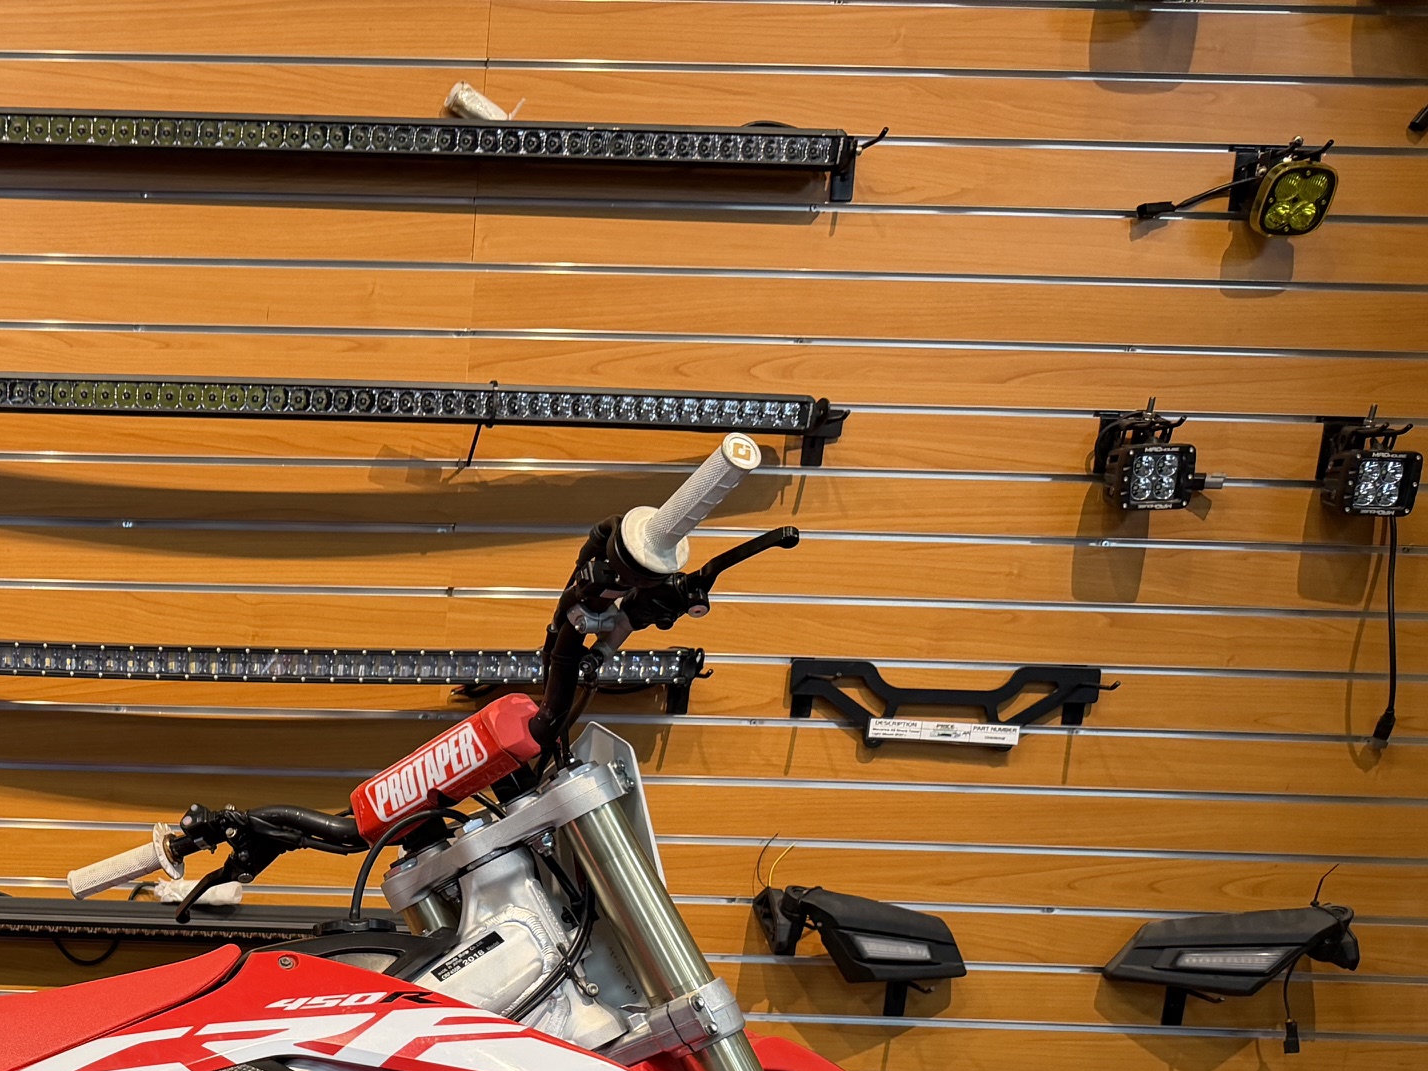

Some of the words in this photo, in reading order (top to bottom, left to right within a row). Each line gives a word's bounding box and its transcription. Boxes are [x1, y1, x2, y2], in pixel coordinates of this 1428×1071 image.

[374, 728, 478, 818] PROTAPER
[462, 949, 485, 966] 2018
[264, 991, 443, 1011] 450R
